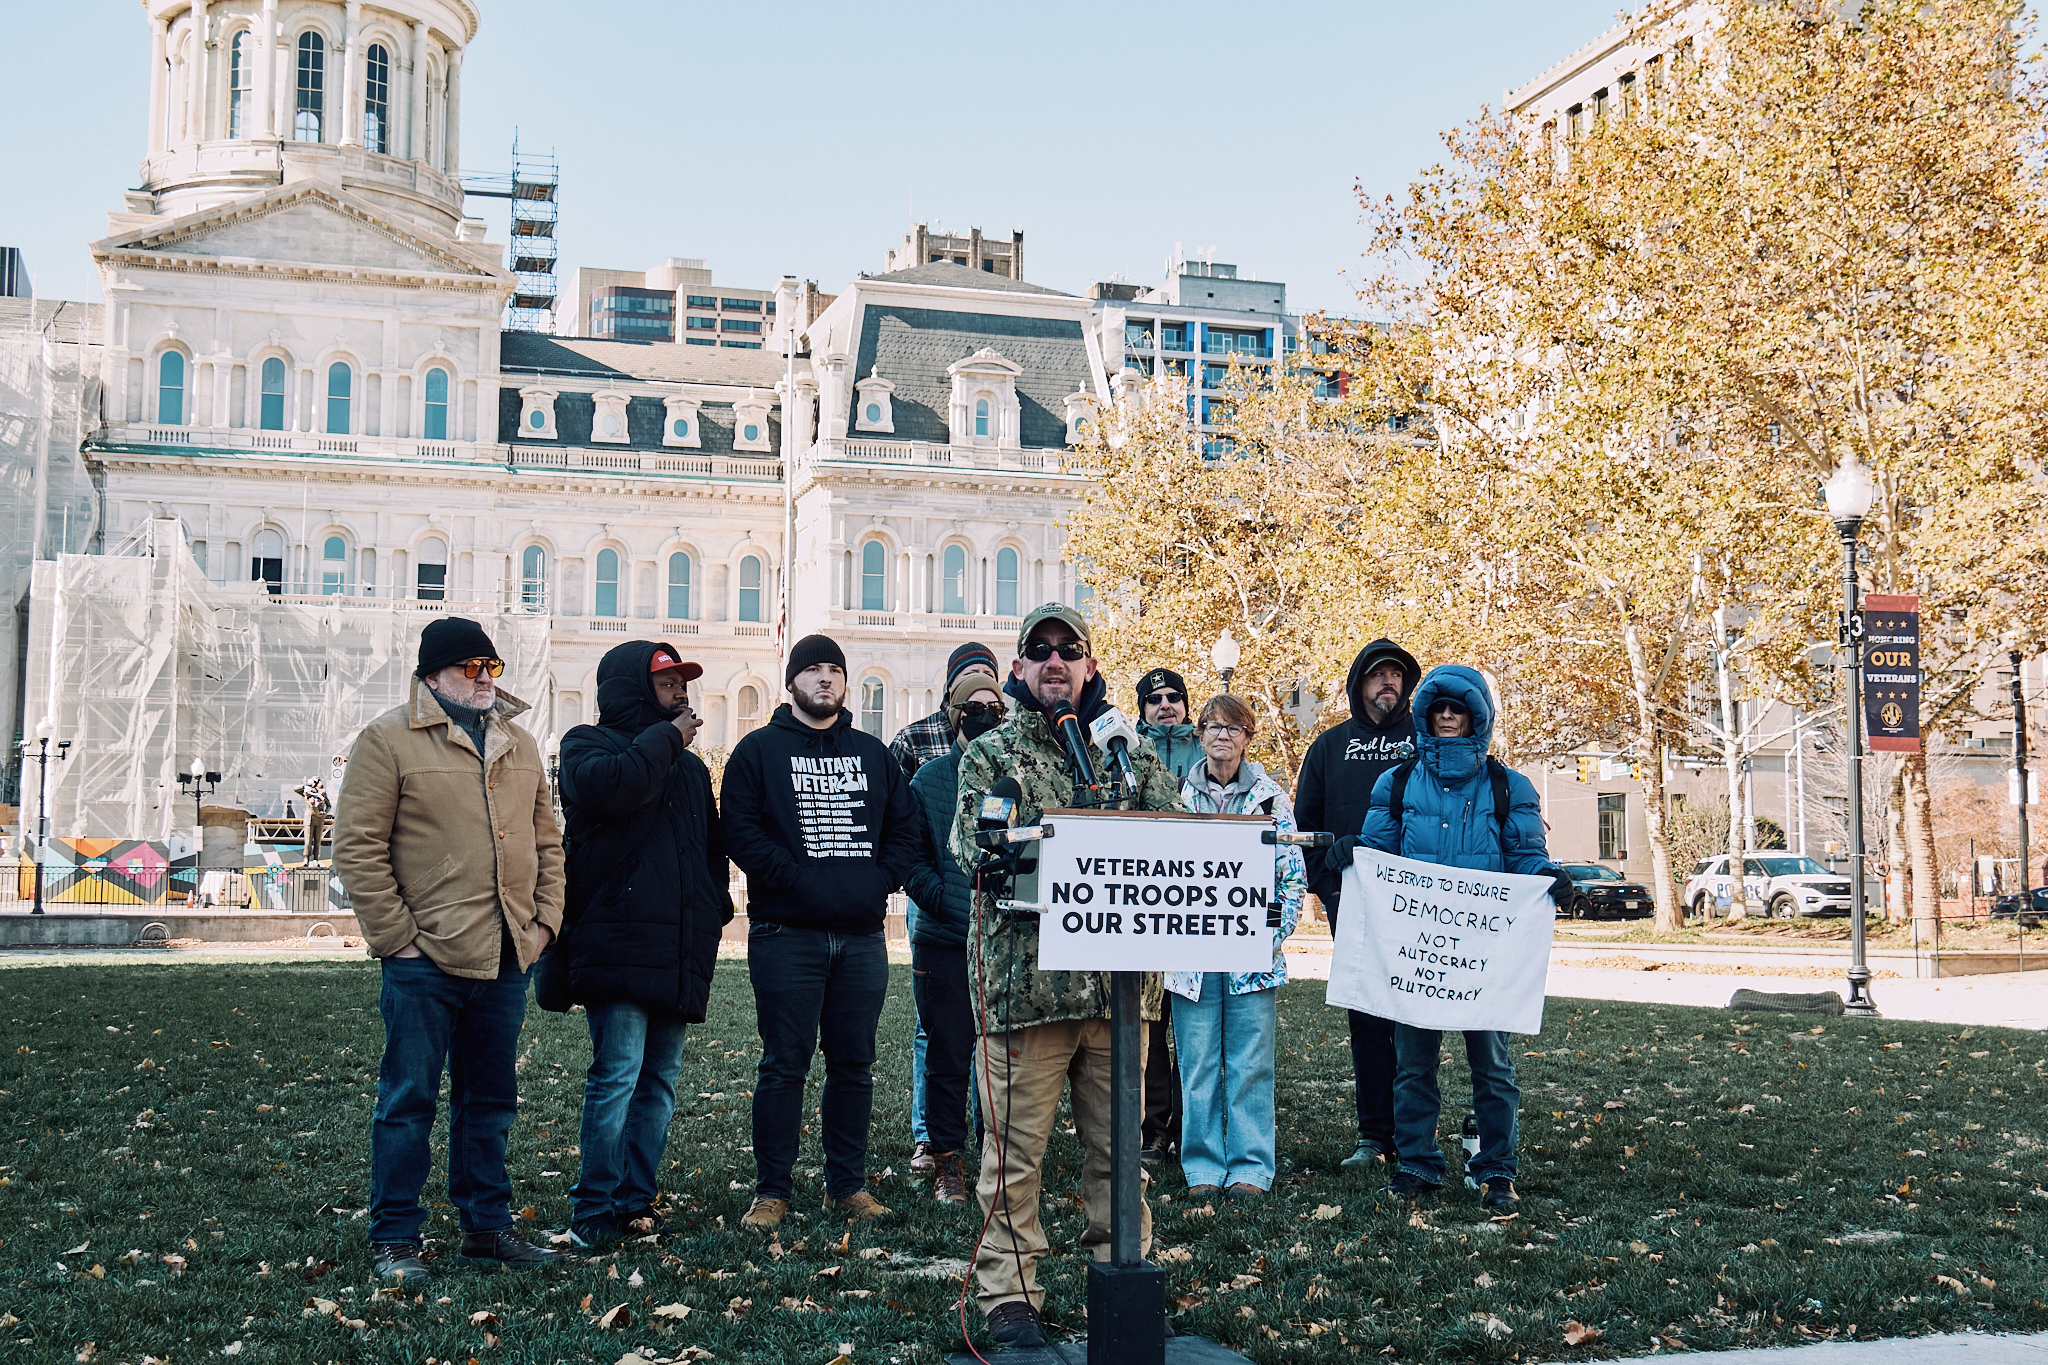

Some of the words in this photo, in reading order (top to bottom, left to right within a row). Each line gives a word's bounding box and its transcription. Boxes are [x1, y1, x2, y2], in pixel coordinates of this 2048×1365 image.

[1851, 614, 1863, 638] 3
[1871, 651, 1912, 667] OUR
[1866, 673, 1917, 683] VETERANS
[1380, 735, 1411, 752] Local
[790, 756, 862, 774] MILITARY
[1076, 857, 1195, 878] VETERANS
[1203, 860, 1243, 878] SAY
[1376, 864, 1395, 883] WE
[1396, 869, 1433, 889] SERVED
[1437, 877, 1453, 892] TO
[1457, 881, 1511, 901] ENSURE
[1717, 883, 1762, 900] POCE
[1052, 882, 1094, 904] NO
[1104, 883, 1218, 907] TROOPS
[1227, 886, 1267, 908] ON
[1062, 911, 1122, 933] OUR
[1133, 912, 1256, 936] STREETS.
[1392, 893, 1517, 933] DEMOCRACY
[1417, 932, 1461, 950] NOT
[1398, 946, 1488, 972] AUTOCRACY
[1414, 967, 1447, 983] NOT
[1390, 975, 1483, 1001] PLUTOCRACY
